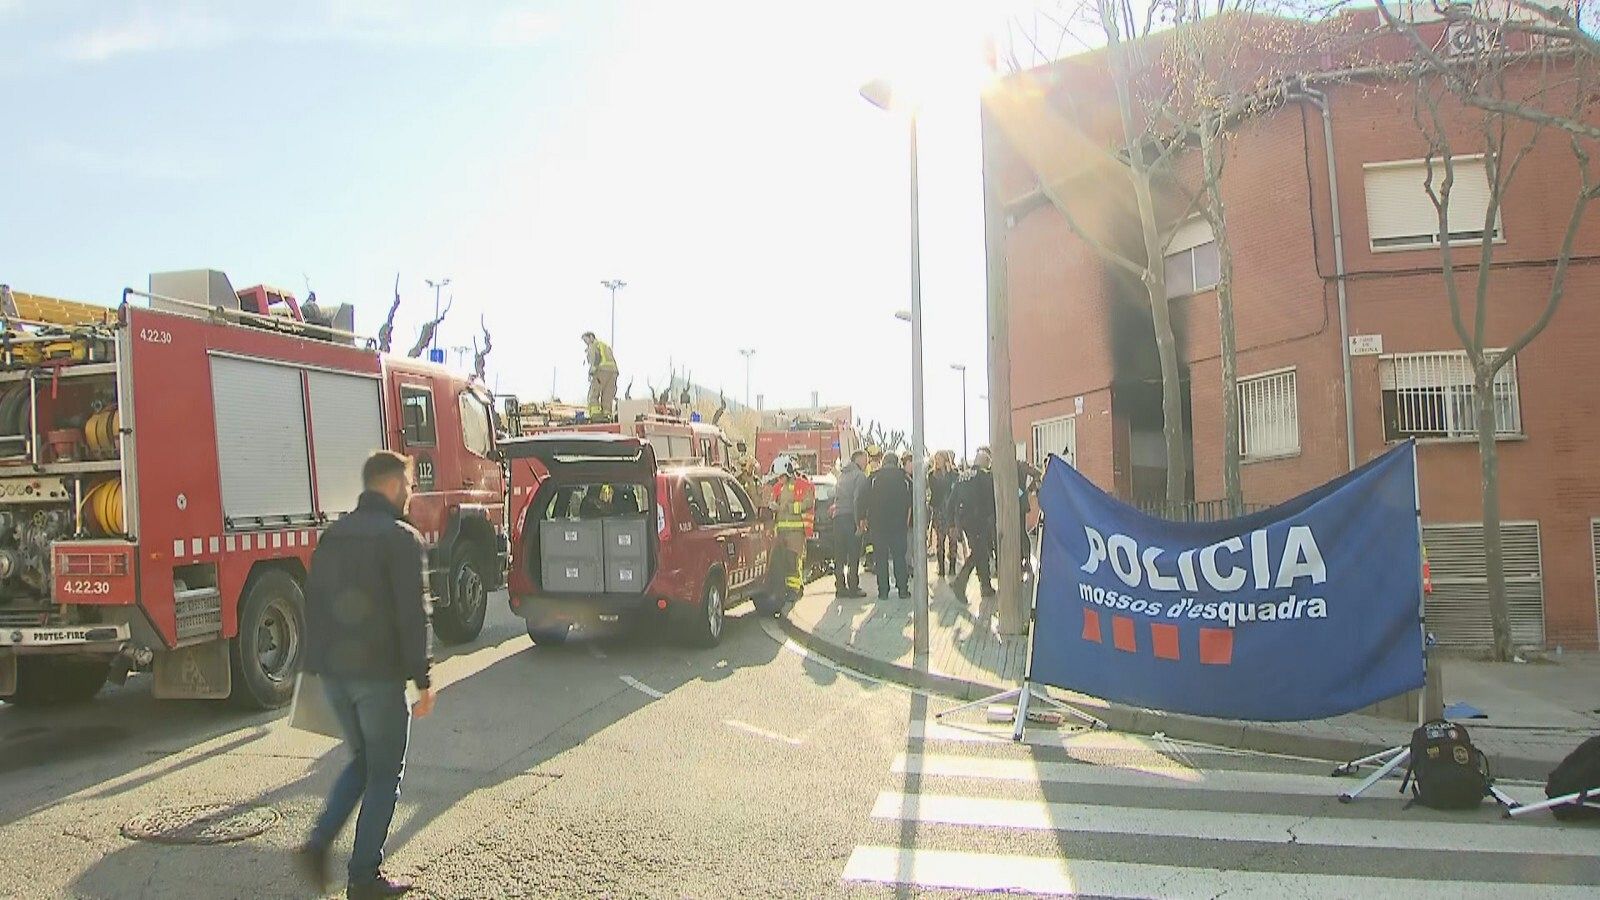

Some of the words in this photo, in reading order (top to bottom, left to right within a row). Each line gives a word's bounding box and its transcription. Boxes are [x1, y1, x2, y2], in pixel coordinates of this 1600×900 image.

[140, 328, 172, 344] 4.22.30
[419, 463, 432, 479] 112
[1080, 525, 1327, 592] POLICIA
[64, 581, 110, 594] 4.22.30
[1079, 582, 1163, 616] mossos
[1167, 595, 1327, 627] d'esquadra
[34, 631, 85, 641] PROTEC-FIRE
